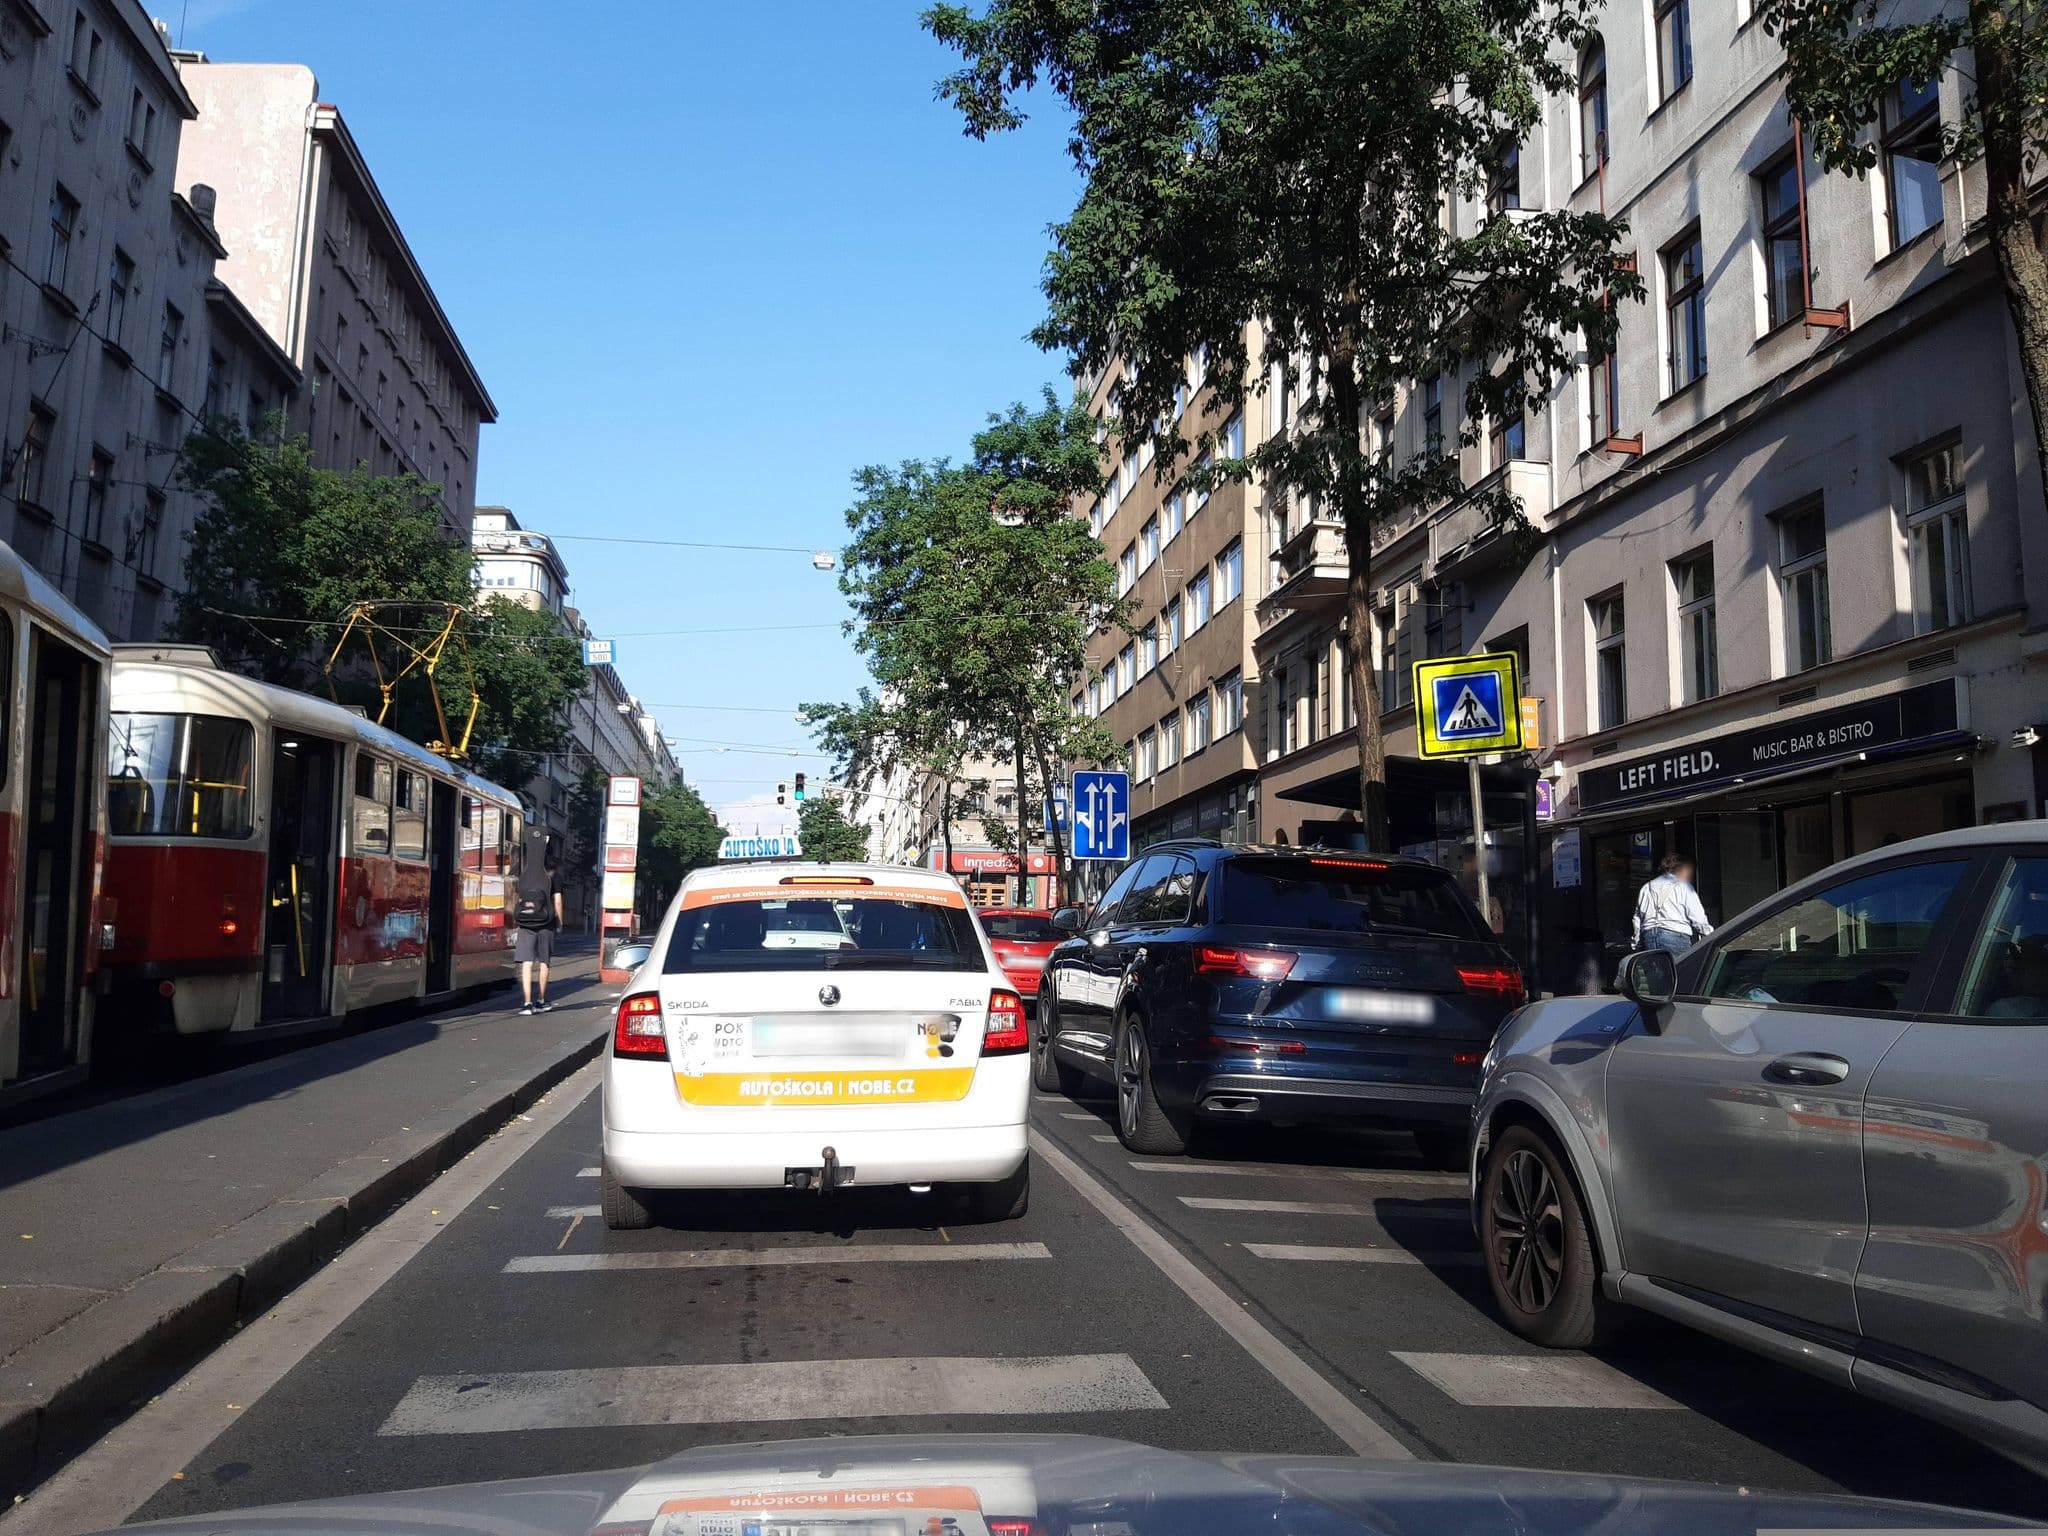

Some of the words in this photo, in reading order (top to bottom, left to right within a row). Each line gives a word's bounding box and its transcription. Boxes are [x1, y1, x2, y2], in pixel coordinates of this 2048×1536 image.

[1752, 740, 1788, 761] MUSIC
[1790, 734, 1814, 753] BAR
[1816, 731, 1826, 747] &
[1828, 720, 1874, 744] BISTRO
[1619, 763, 1657, 791] LEFT
[1663, 750, 1720, 781] FIELD.
[949, 998, 982, 1007] FABIA
[740, 1078, 833, 1096] AUTOŠKOLA
